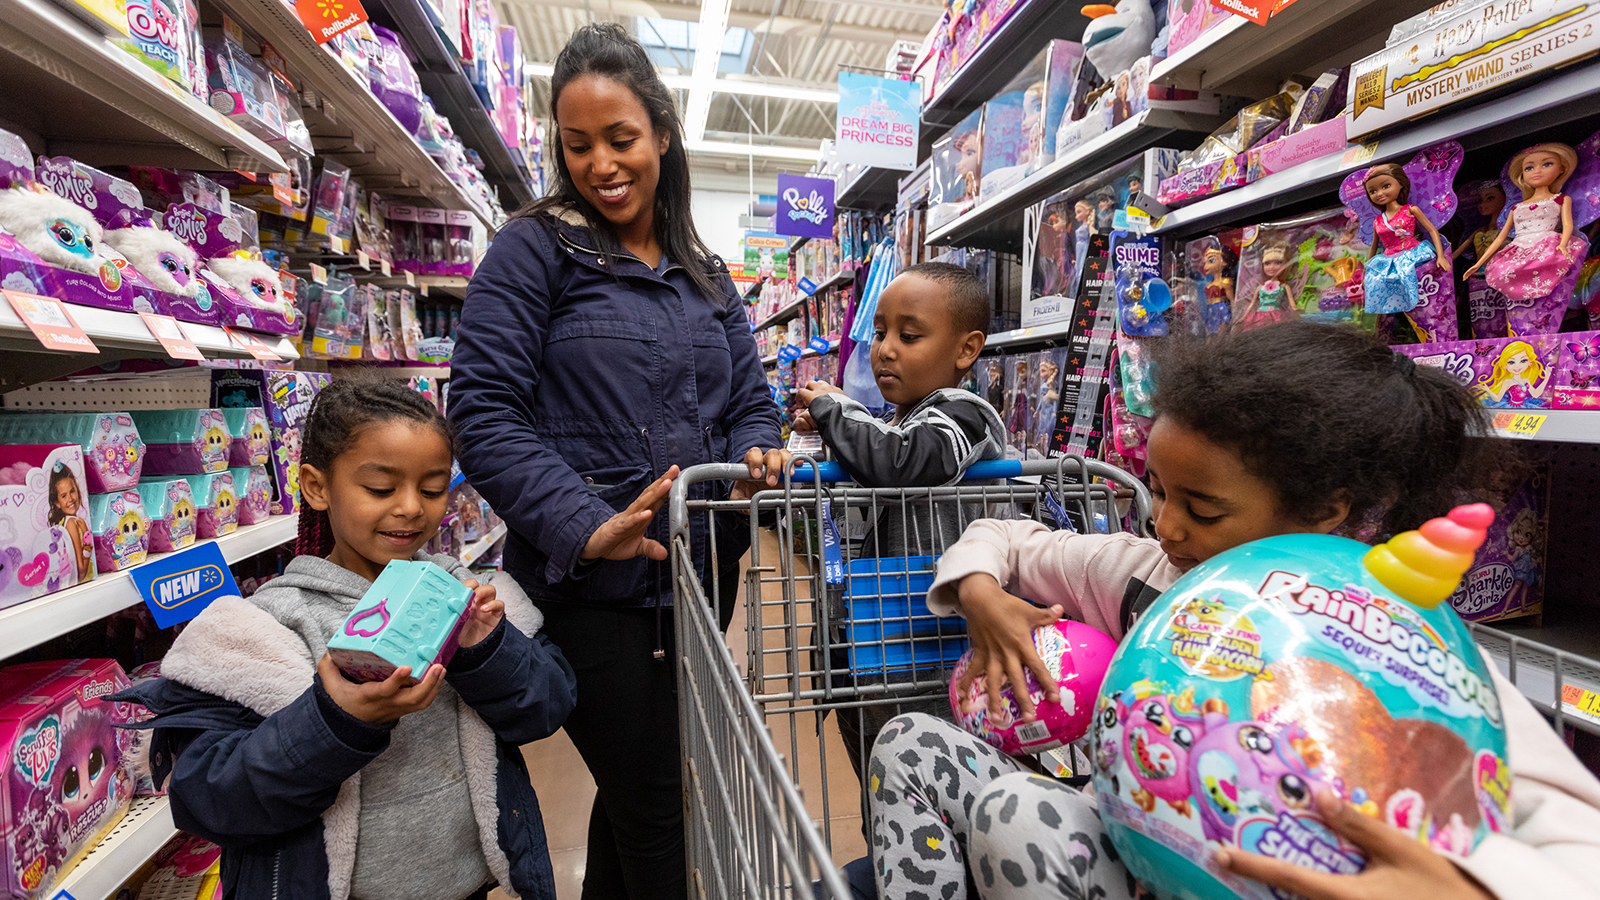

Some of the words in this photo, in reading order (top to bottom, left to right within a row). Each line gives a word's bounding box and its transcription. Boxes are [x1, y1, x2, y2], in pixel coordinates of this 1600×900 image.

[321, 13, 360, 37] Rollback
[140, 42, 175, 62] TEACH
[1406, 72, 1463, 107] MYSTERY
[1465, 57, 1504, 84] WAND
[1509, 29, 1579, 67] SERIES
[1582, 23, 1593, 38] 2
[1360, 69, 1382, 85] COLLECT
[1451, 85, 1474, 98] CONTAINS
[1478, 81, 1484, 89] OF
[1489, 70, 1513, 84] MYSTERY
[1514, 62, 1533, 75] WANDS
[1358, 87, 1377, 100] SERIES
[1376, 85, 1381, 93] 2
[1364, 82, 1374, 90] ALL
[1360, 93, 1379, 106] WANDS
[842, 116, 889, 131] DREAM
[1281, 148, 1310, 164] Necklace
[1310, 140, 1337, 155] Activity
[1295, 138, 1321, 152] Squishy
[766, 239, 786, 247] Critters
[1116, 246, 1160, 264] SLIME
[103, 264, 116, 274] TRY
[104, 272, 117, 284] ME
[1086, 279, 1104, 288] HAIR
[65, 278, 79, 287] TURN
[79, 279, 97, 292] COLORS
[97, 289, 107, 299] INTO
[1470, 291, 1506, 309] arkle
[1033, 304, 1056, 317] FROZEN
[50, 332, 92, 346] Rollback
[1072, 335, 1090, 344] HAIR
[215, 376, 261, 387] HATCHIMALS
[1065, 374, 1082, 382] HAIR
[1081, 375, 1102, 385] CHALK
[24, 566, 42, 582] Series
[1471, 568, 1491, 582] ZURU
[160, 570, 200, 604] NEW
[1452, 566, 1513, 608] Sparkle
[1473, 591, 1503, 612] Girlz
[1189, 623, 1210, 632] CAN
[1236, 630, 1262, 642] FIND
[83, 680, 114, 702] Friends
[24, 858, 42, 883] NEW
